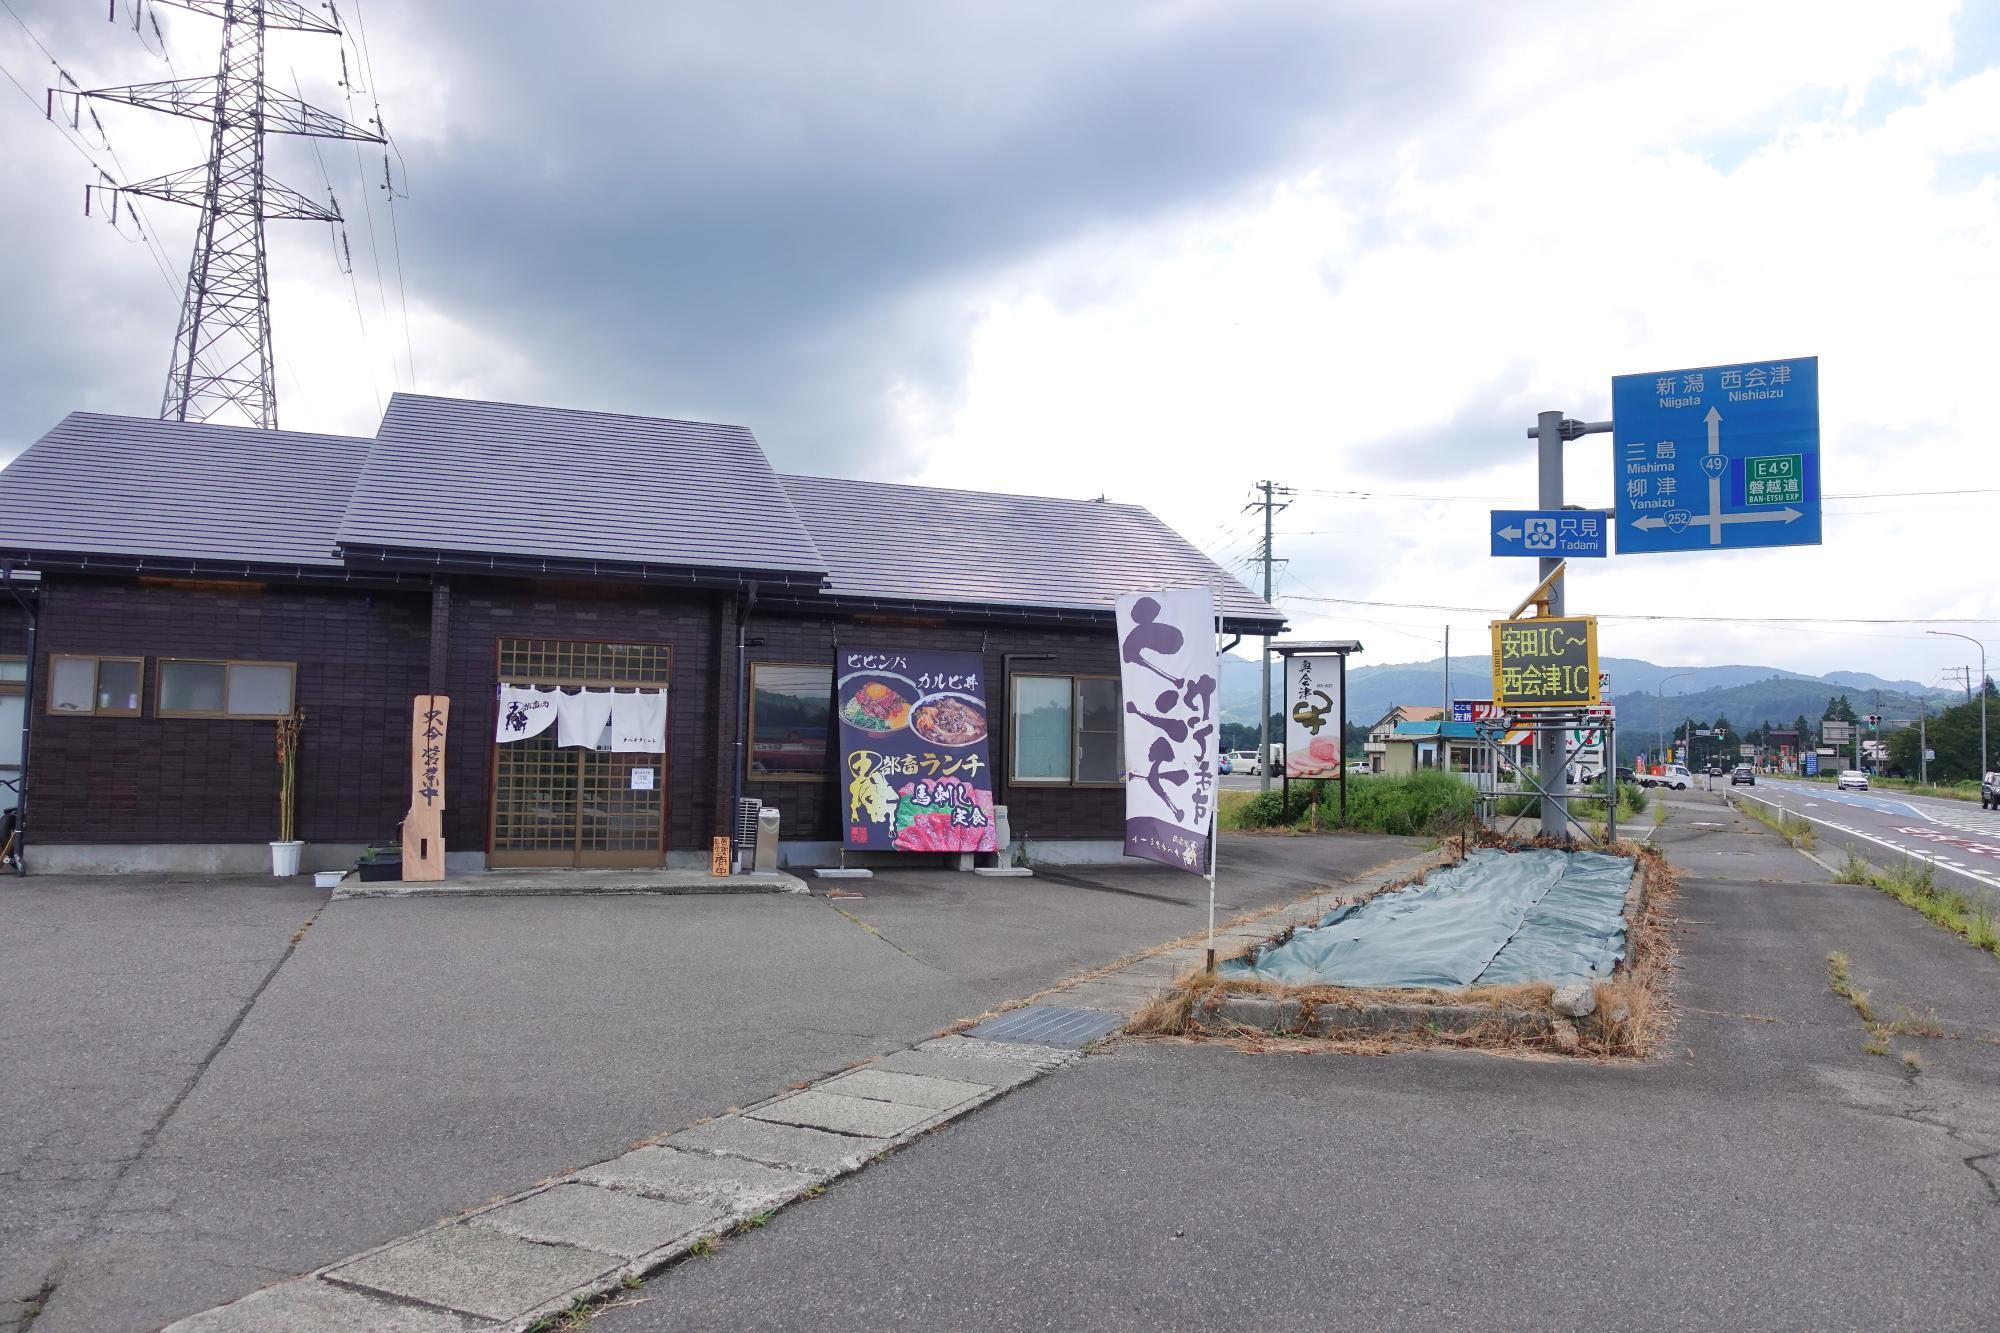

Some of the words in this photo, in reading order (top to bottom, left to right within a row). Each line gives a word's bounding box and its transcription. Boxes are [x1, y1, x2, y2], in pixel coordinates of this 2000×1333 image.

[1656, 373, 1704, 396] 新潟
[1720, 365, 1792, 389] 西会津
[1659, 396, 1701, 408] Niigata
[1729, 388, 1784, 402] Nishiaizu
[1626, 440, 1677, 461] 三島
[1627, 462, 1675, 474] Mishima
[1706, 458, 1722, 470] 49
[1758, 461, 1789, 475] E49
[1626, 476, 1677, 498] 柳津
[1749, 478, 1799, 495] 磐越道
[1630, 498, 1675, 510] Yanaizu
[1749, 493, 1784, 503] BAN-ETSU
[1785, 493, 1800, 501] EXP
[1558, 518, 1599, 537] 只見
[1668, 513, 1687, 525] 252
[1559, 540, 1598, 550] Tadami
[847, 653, 907, 670] ビビンバ
[917, 672, 979, 691] カルビ丼
[1298, 659, 1313, 700] 奥会津
[1502, 663, 1589, 696] 西会津IC
[1454, 712, 1472, 721] 左折
[912, 783, 972, 806] 馬刺し
[952, 807, 987, 826] 定食
